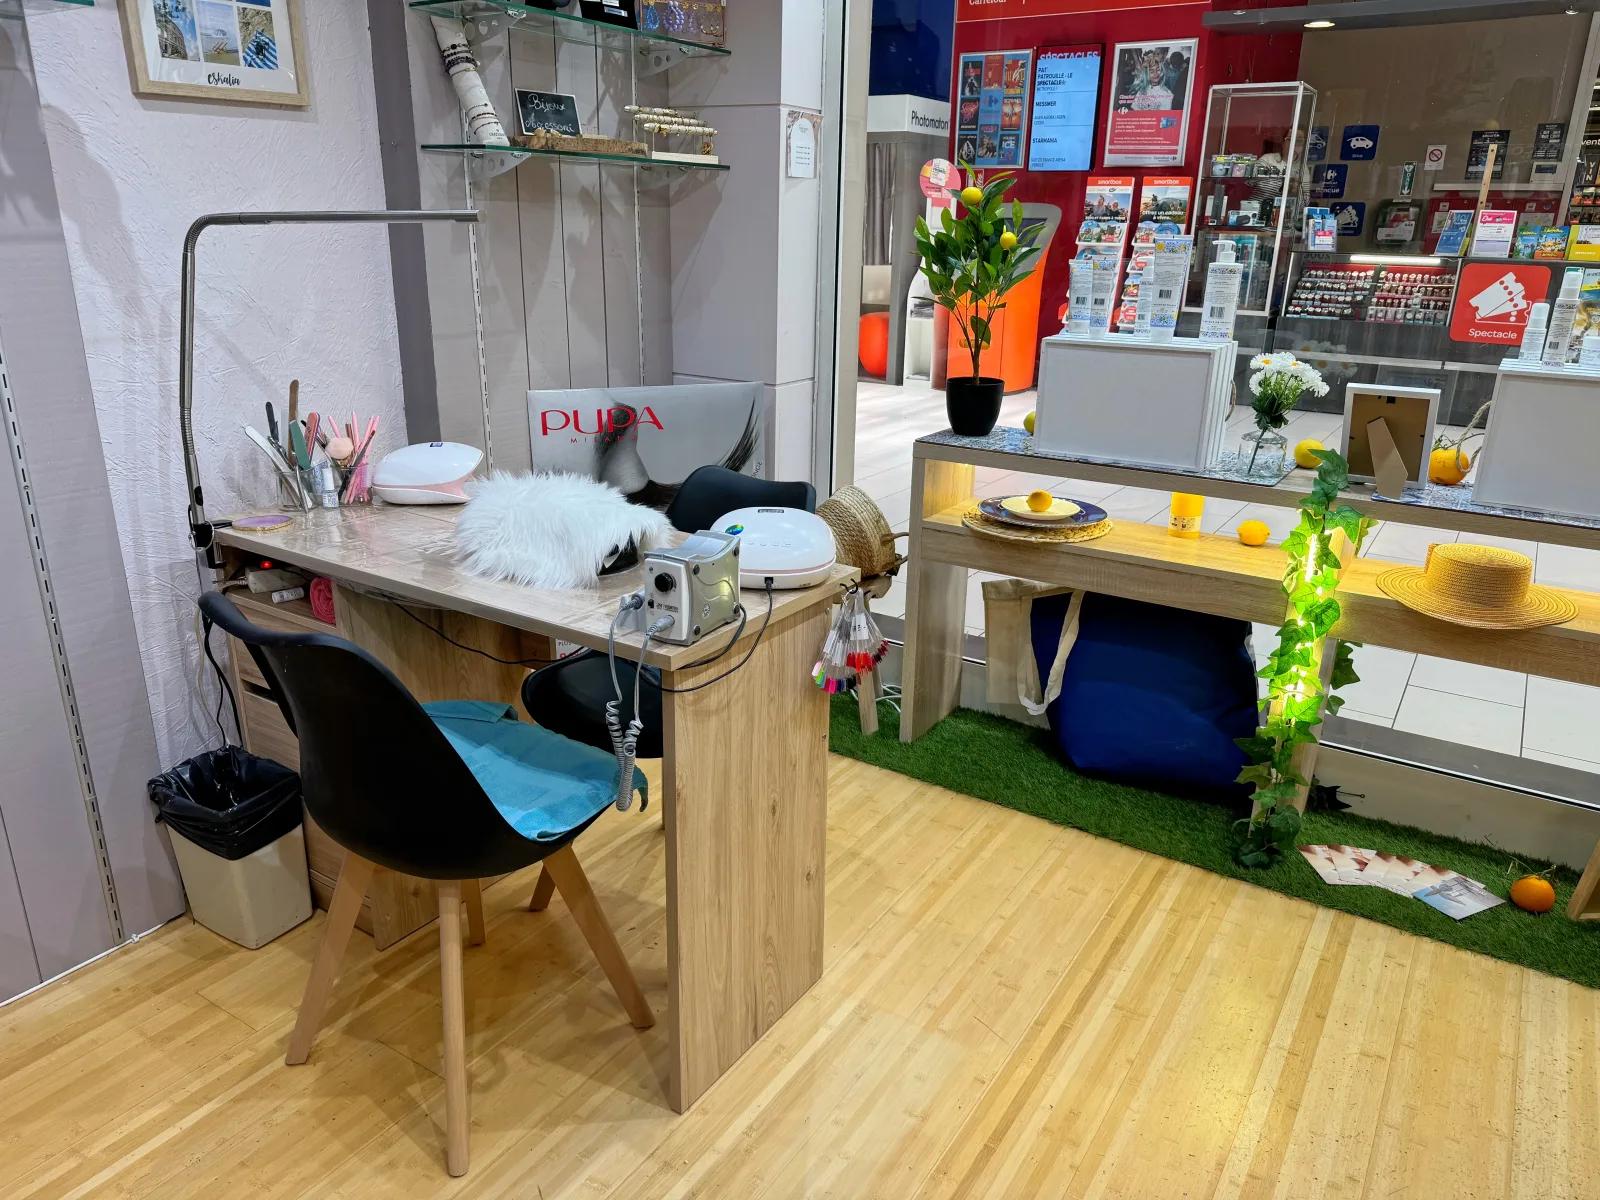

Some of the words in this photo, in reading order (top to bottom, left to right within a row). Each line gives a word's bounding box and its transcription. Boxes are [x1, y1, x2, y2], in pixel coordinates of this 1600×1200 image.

[528, 93, 566, 112] Bijoux
[911, 110, 949, 130] Photomaton
[1468, 328, 1517, 339] Spectacle
[541, 406, 664, 436] PUPA
[570, 434, 638, 443] MILANO
